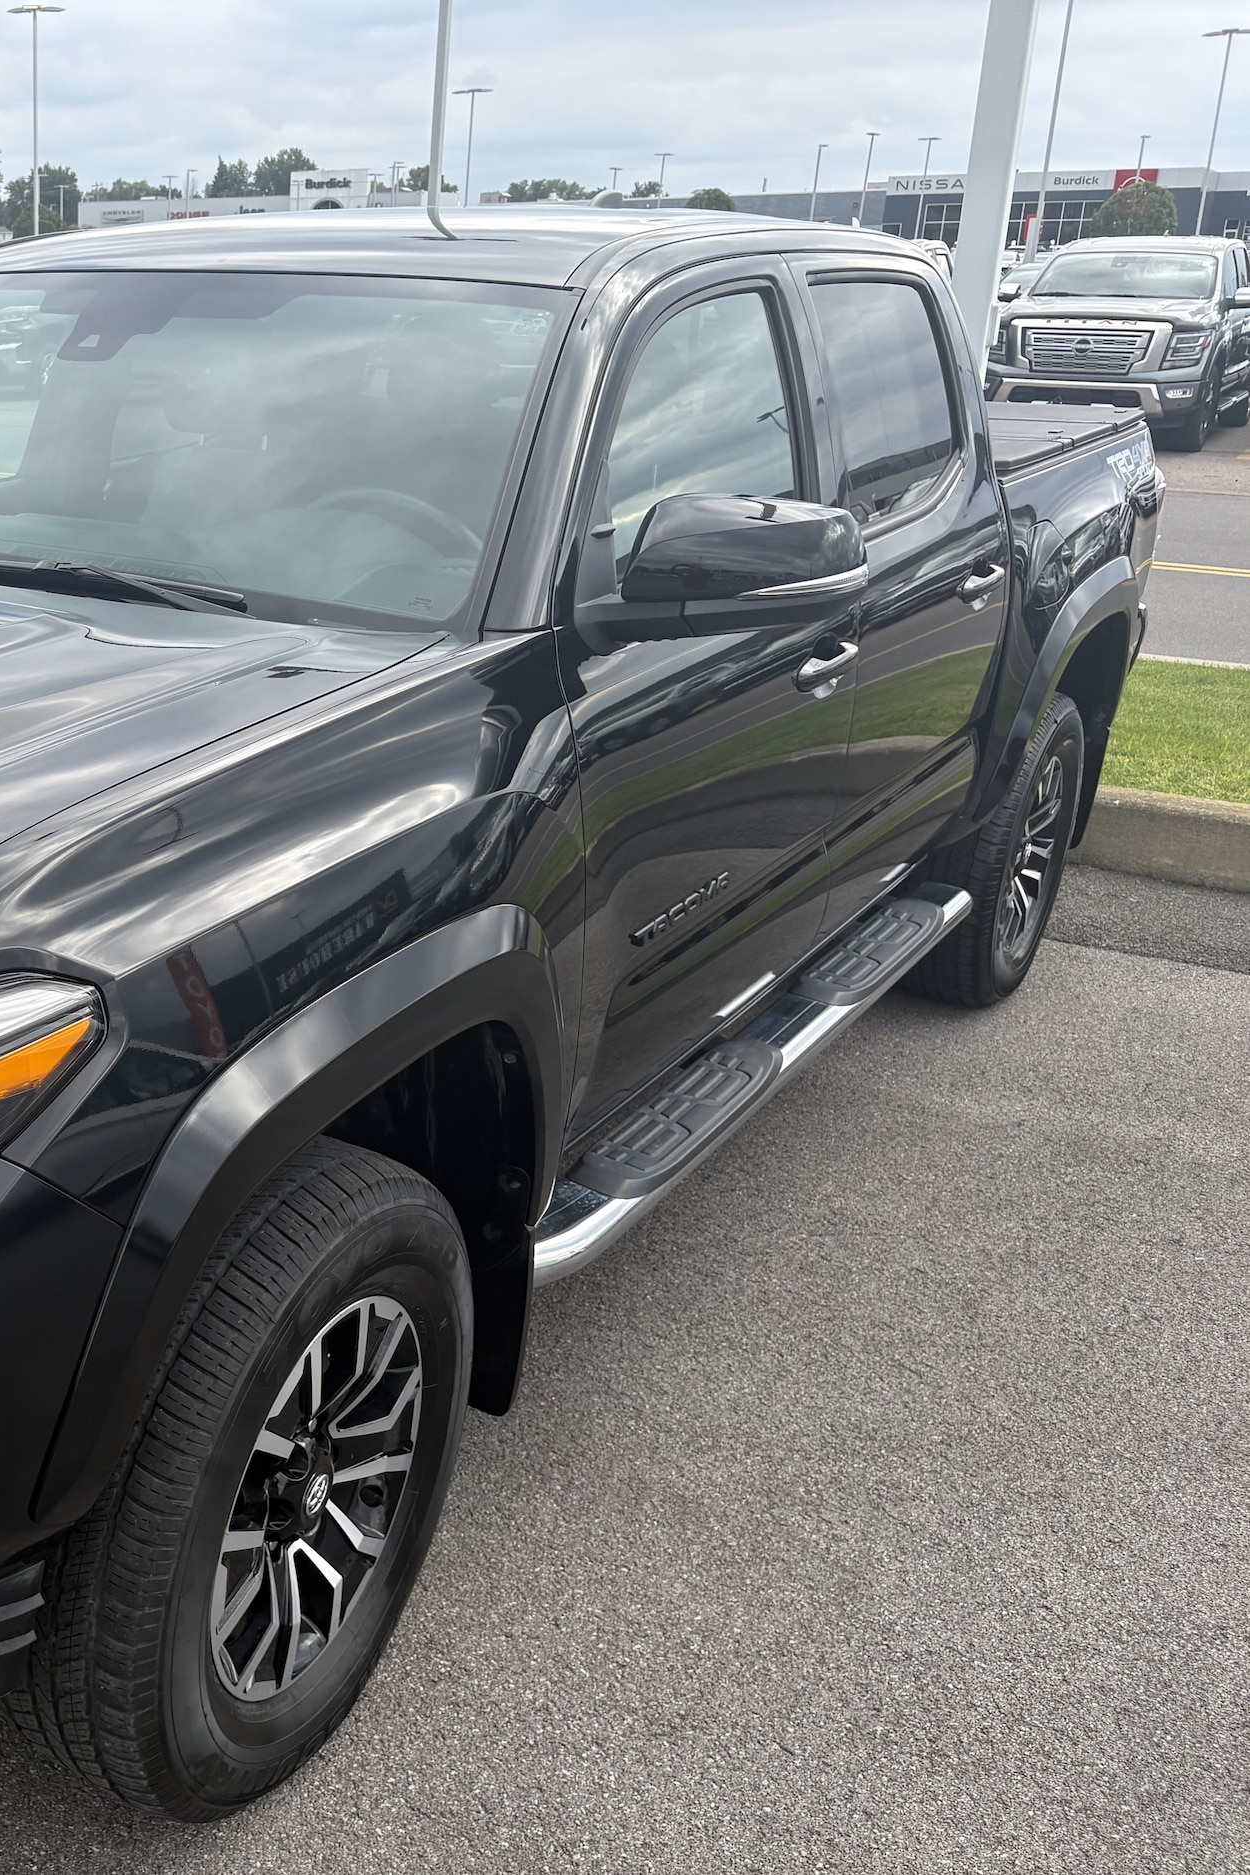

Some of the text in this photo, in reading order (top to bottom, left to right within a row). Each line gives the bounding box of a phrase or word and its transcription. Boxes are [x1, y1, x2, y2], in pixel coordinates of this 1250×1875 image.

[305, 178, 352, 189] Burdick
[895, 179, 964, 191] NISSA
[1053, 176, 1099, 186] Burdick
